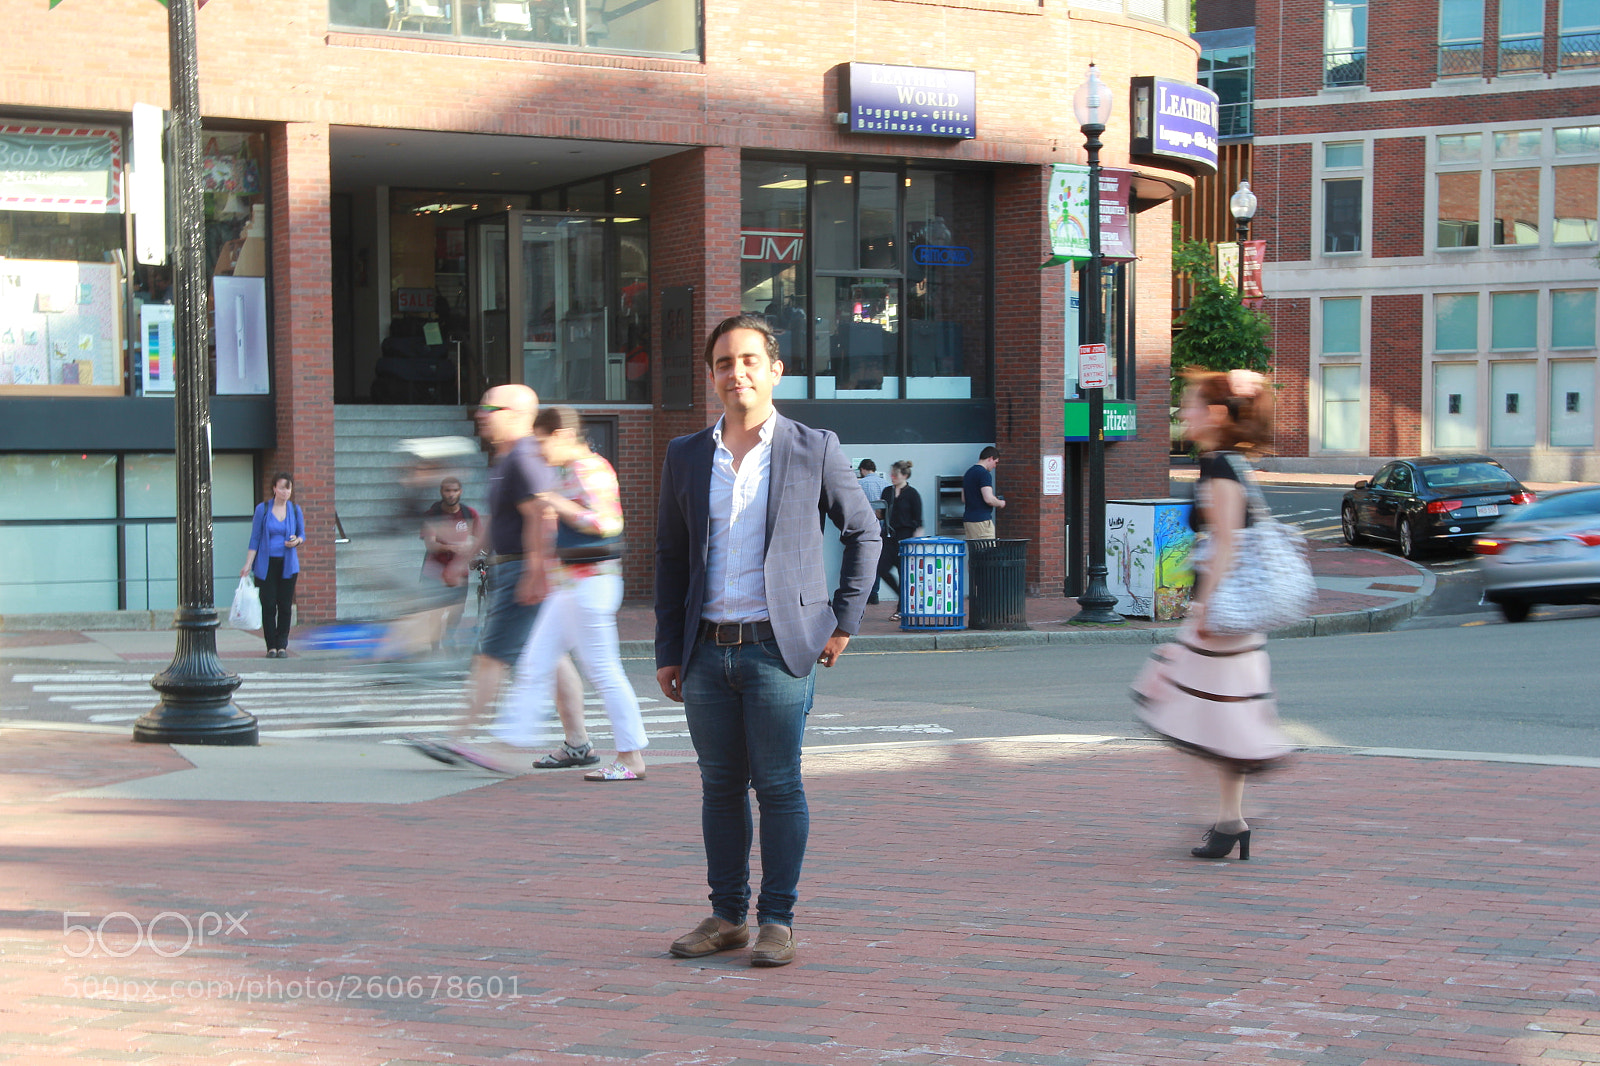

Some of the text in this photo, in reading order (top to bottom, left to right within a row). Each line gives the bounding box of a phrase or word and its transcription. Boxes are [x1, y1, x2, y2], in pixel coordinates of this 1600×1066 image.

[896, 86, 959, 108] WORLD
[1159, 86, 1211, 126] LEATHER
[858, 105, 917, 120] Luggage
[932, 110, 968, 122] Gifts
[858, 119, 970, 135] Business Cases
[0, 141, 103, 168] Bob Slate
[740, 231, 804, 261] UMI
[399, 293, 436, 307] SALE
